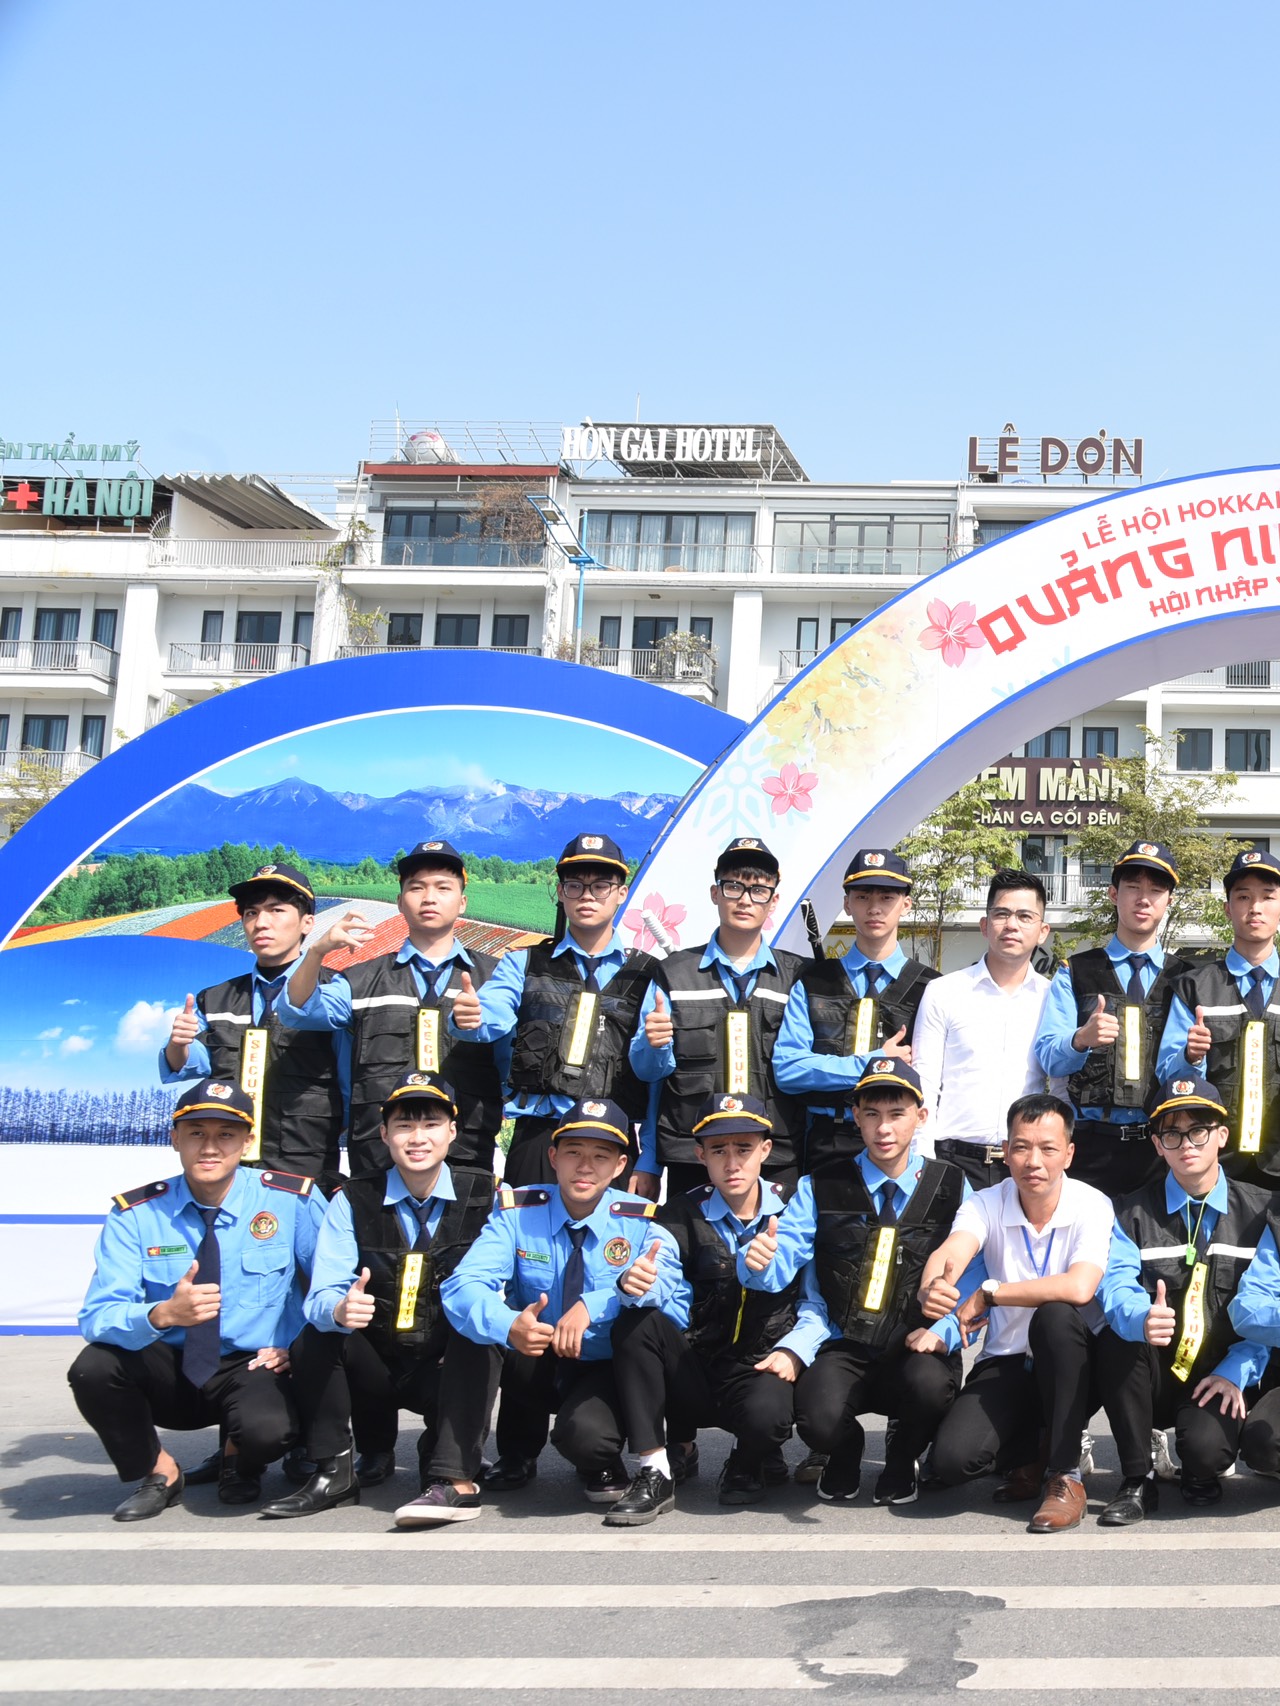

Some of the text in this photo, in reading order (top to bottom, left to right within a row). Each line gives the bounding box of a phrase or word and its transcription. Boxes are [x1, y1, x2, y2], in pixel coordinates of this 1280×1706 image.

[28, 431, 97, 461] THẨM
[101, 440, 140, 461] MỸ
[561, 415, 763, 462] HÒN GAI HOTEL
[968, 422, 1021, 474] LÊ
[42, 470, 88, 516] HÀ
[94, 471, 154, 527] NỘI
[1082, 515, 1116, 550] LỄ
[1121, 506, 1170, 537] HỘI
[976, 537, 1195, 656] QUẢNG
[1149, 590, 1192, 618] HỘI
[1196, 575, 1269, 606] NHẬP
[972, 807, 1015, 825] CHĂN
[1020, 810, 1045, 825] GA
[1050, 806, 1082, 825] GỐI
[404, 1256, 418, 1324] SECURITY
